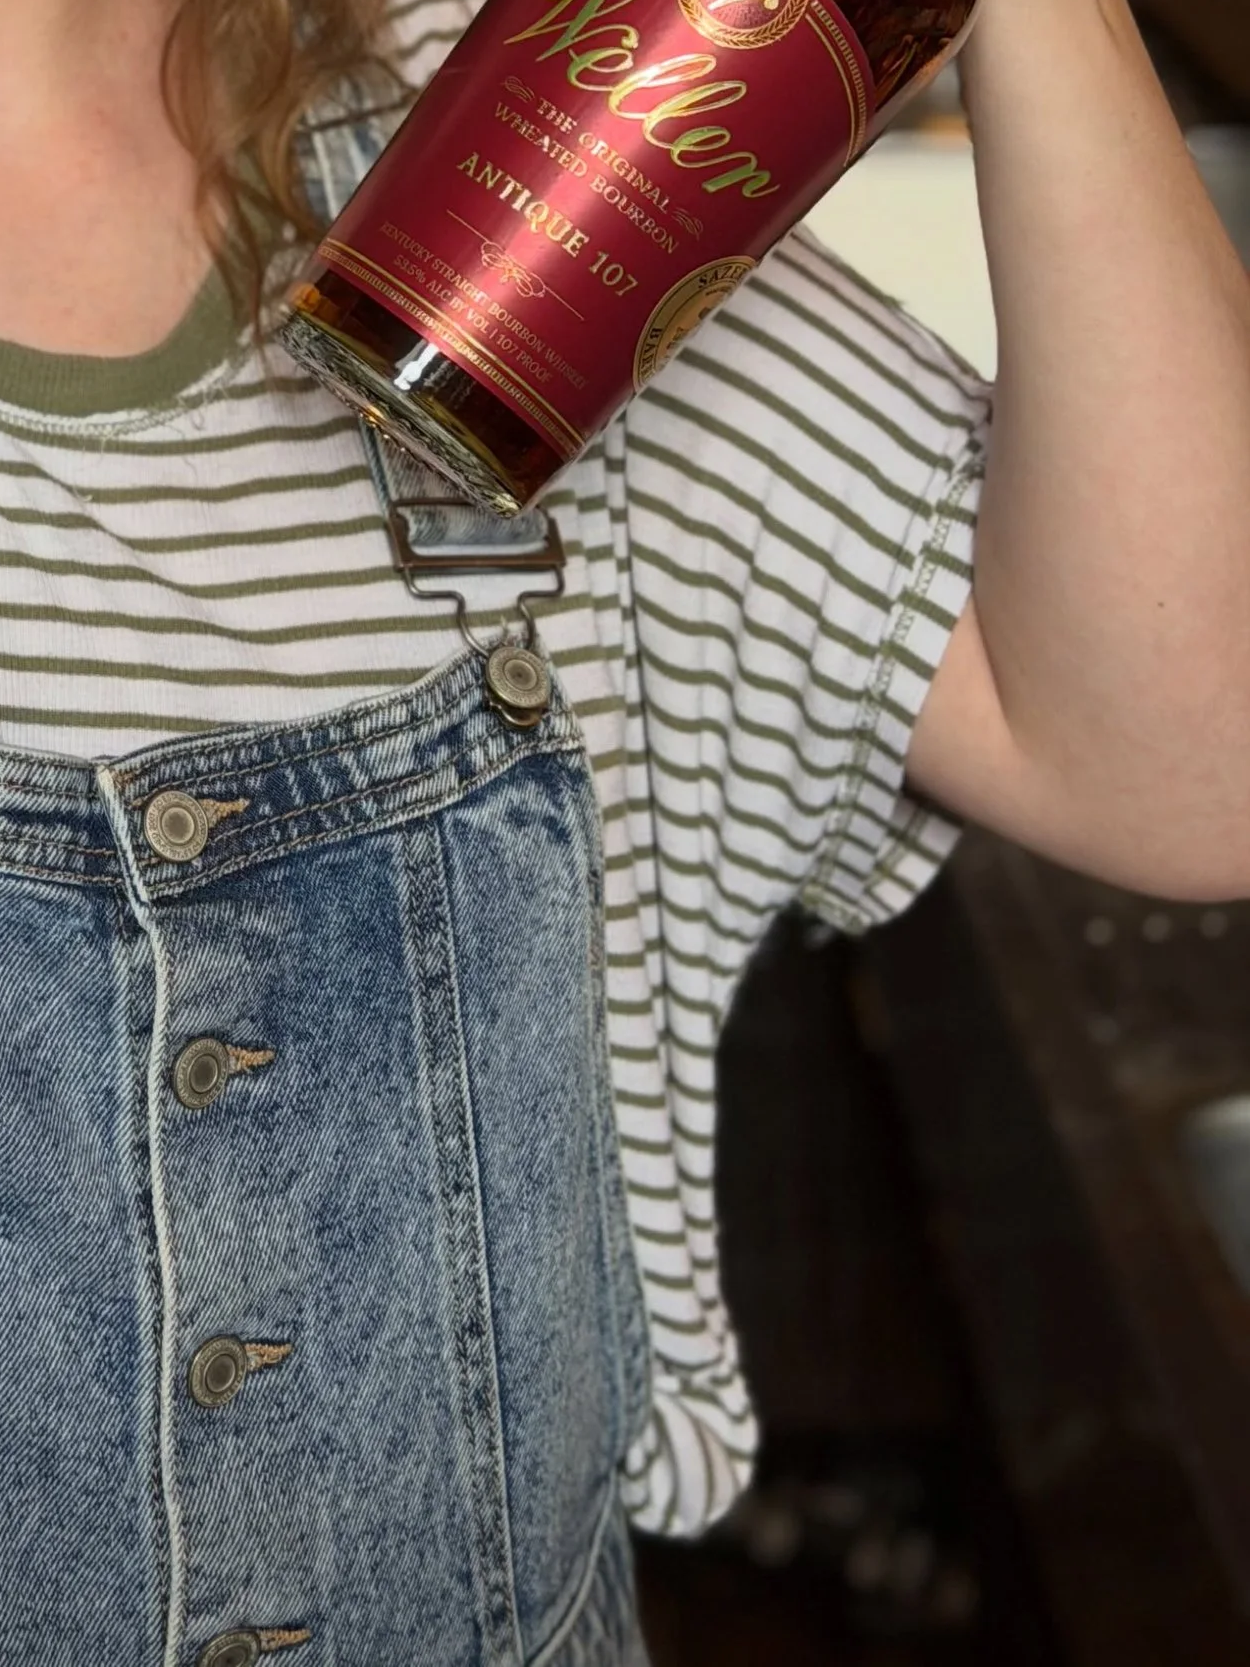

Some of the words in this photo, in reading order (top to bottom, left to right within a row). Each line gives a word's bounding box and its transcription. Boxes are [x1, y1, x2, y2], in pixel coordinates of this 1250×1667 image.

[494, 101, 589, 179] WHEATED
[588, 173, 680, 255] BOURBON
[536, 97, 579, 135] THE
[578, 131, 672, 215] ORIGINAL
[380, 221, 435, 263] KENTUCKY
[431, 257, 492, 309] STRAIGHT
[488, 301, 546, 354] BOURBON
[456, 151, 591, 258] ANTIQUE
[588, 250, 640, 298] 107
[425, 273, 452, 302] ALC
[450, 298, 468, 315] BY
[466, 309, 490, 334] VOL
[496, 333, 519, 354] 107
[516, 350, 553, 383] PROOF
